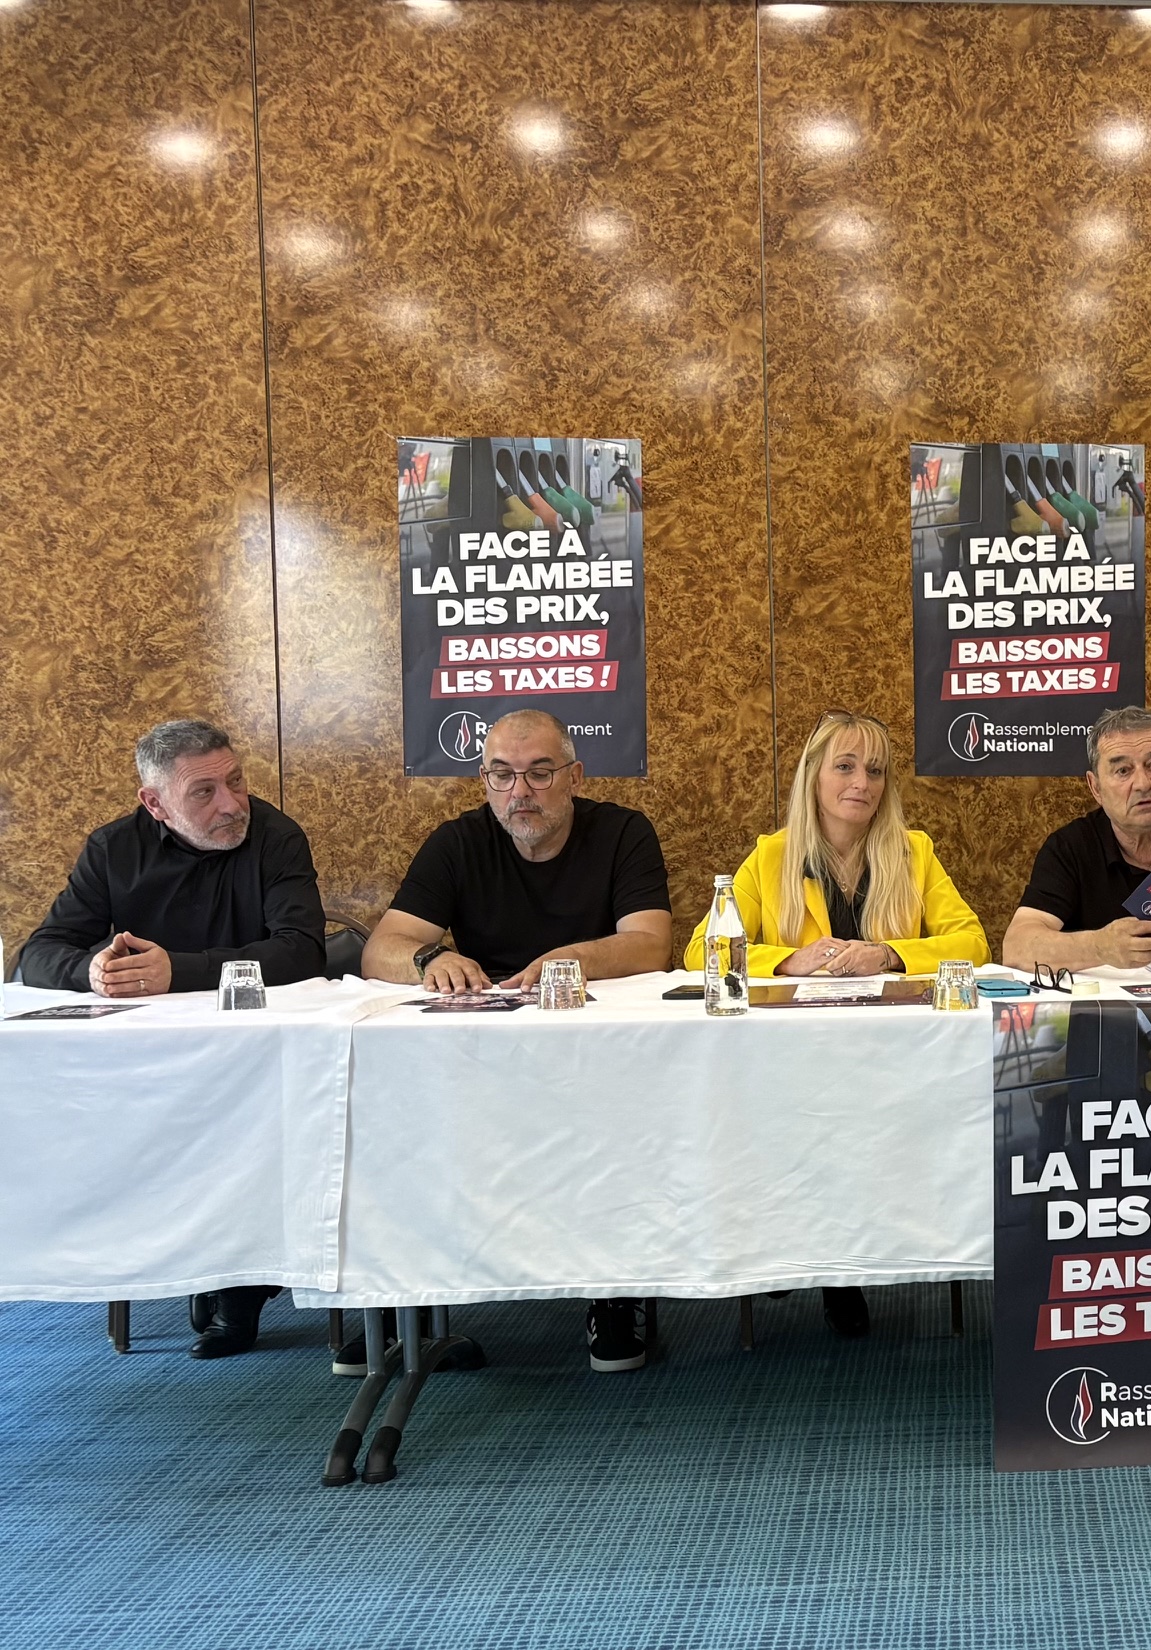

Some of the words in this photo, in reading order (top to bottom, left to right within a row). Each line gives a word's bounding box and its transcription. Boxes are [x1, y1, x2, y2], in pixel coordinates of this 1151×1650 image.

[459, 530, 550, 561] FACE
[557, 522, 585, 557] À
[969, 535, 1058, 565] FACE
[1063, 527, 1090, 561] À
[412, 567, 458, 595] LA
[466, 554, 633, 592] FLAMBÉE
[924, 571, 968, 598] LA
[975, 557, 1135, 596] FLAMBÉE
[437, 598, 508, 626] DES
[516, 594, 609, 625] PRIX,
[948, 600, 1015, 629] DES
[1023, 597, 1112, 628] PRIX,
[448, 634, 600, 662] BAISSONS
[958, 637, 1103, 664] BAISSONS
[440, 668, 493, 693] LES
[499, 666, 593, 691] TAXES
[600, 665, 610, 687] !
[950, 672, 1001, 695] LES
[1007, 669, 1096, 692] TAXES
[1102, 667, 1112, 688] !
[984, 722, 1094, 736] Rassembleme
[984, 738, 1054, 752] National
[1011, 1151, 1078, 1196] LA
[1047, 1196, 1150, 1240] DES
[1050, 1304, 1125, 1340] LES
